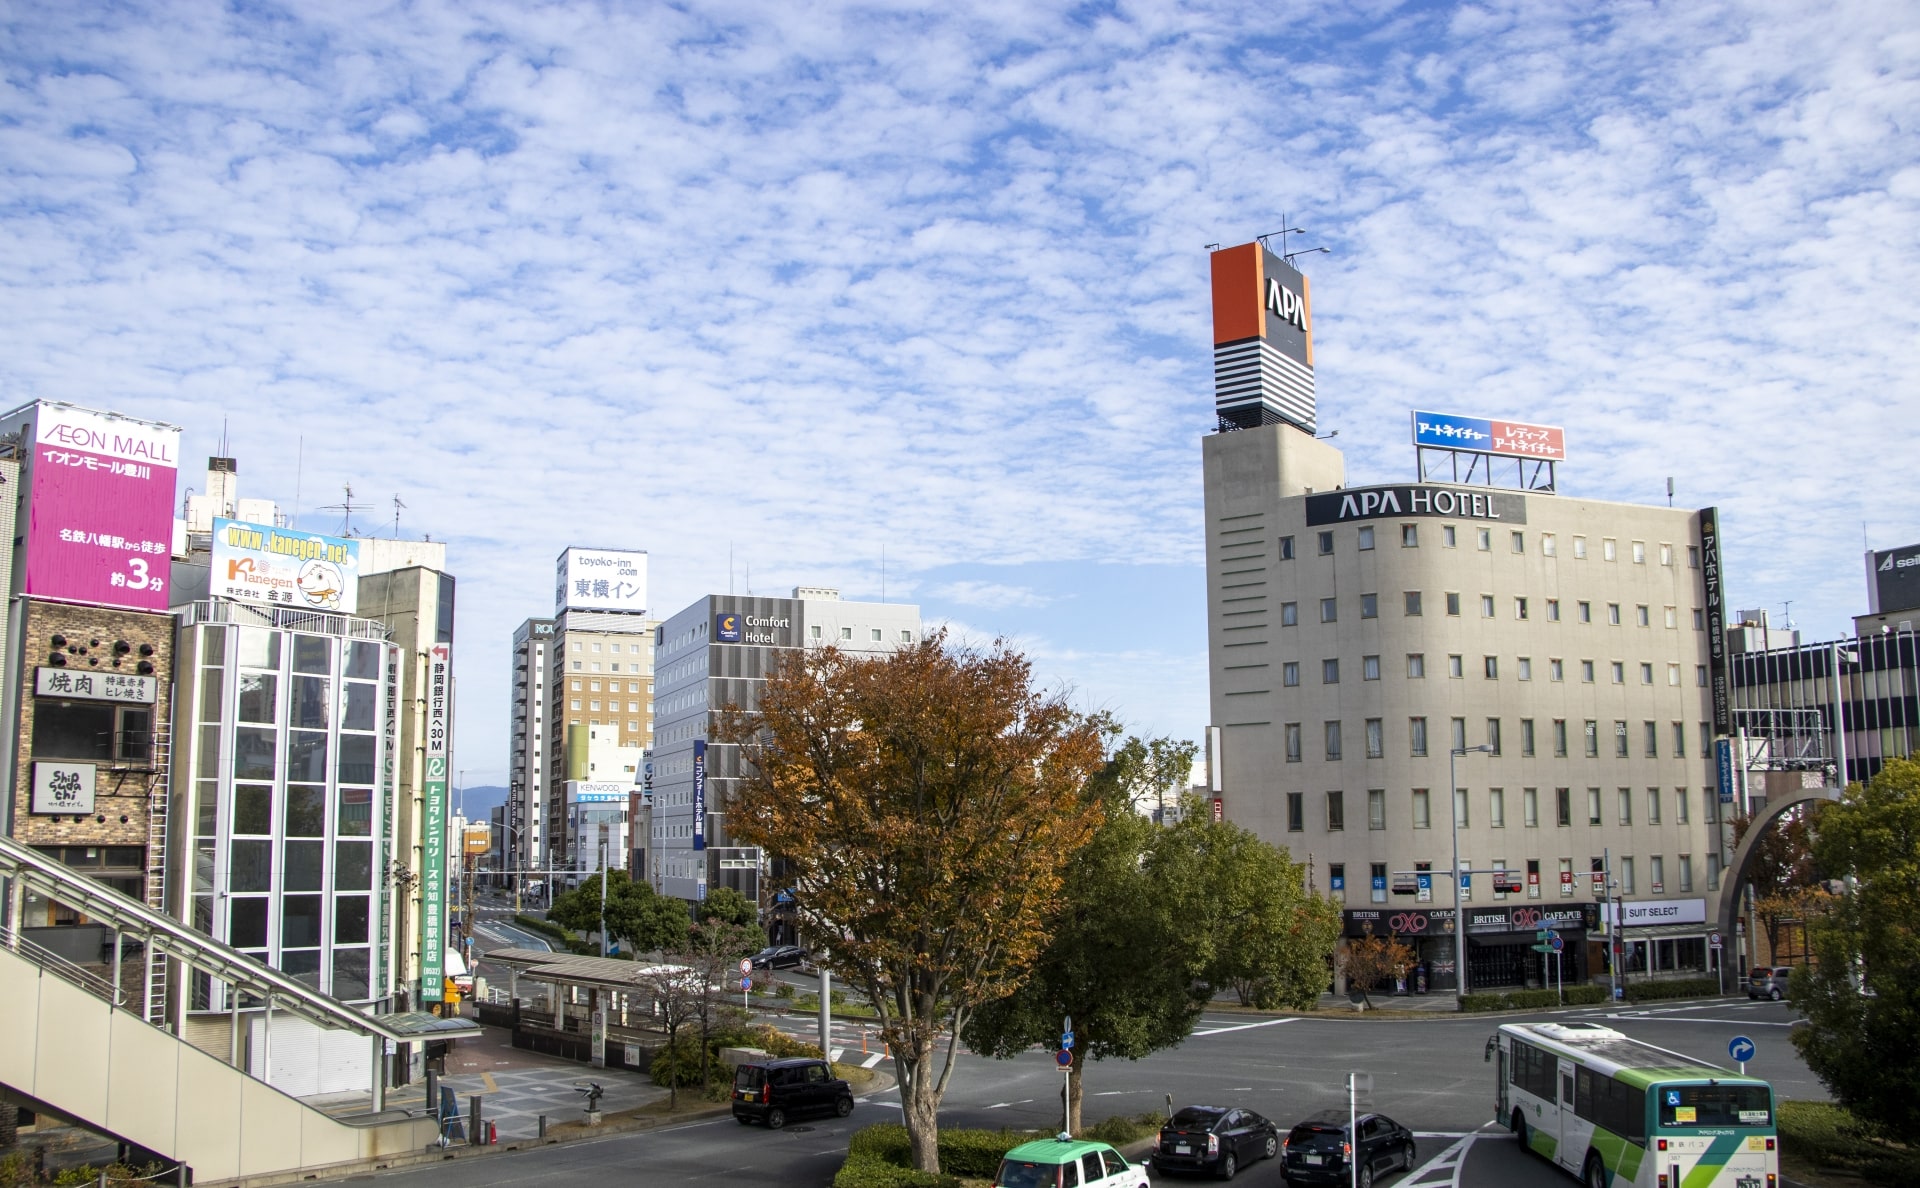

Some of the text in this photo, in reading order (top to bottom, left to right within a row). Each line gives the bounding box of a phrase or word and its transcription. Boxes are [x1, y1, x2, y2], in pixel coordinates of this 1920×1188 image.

[1268, 277, 1308, 332] APA
[1418, 422, 1489, 440] アートネイチャー
[1505, 426, 1550, 441] レディース
[114, 435, 172, 463] MALL
[1493, 437, 1562, 454] アートネイチャー
[42, 450, 150, 480] イオンモール豊川
[1338, 489, 1501, 519] APA HOTEL
[59, 528, 166, 555] 名鉄八幡駅から徒歩
[228, 526, 349, 565] www.kanegen.net
[578, 556, 632, 568] toyoko-inn
[1896, 554, 1920, 568] sei
[110, 557, 164, 592] 約3分
[227, 557, 293, 589] Kanegen
[1703, 535, 1719, 607] アパホテル
[226, 587, 293, 603] 株式会社 金源
[574, 579, 640, 599] 東横イン
[745, 615, 789, 628] Comfort
[745, 631, 775, 644] Hotel
[48, 672, 93, 695] 焼肉
[105, 676, 146, 689] 特選赤身
[105, 688, 145, 701] ヒレ焼き
[580, 784, 620, 792] KENWOOD
[1473, 914, 1505, 924] BRITISH
[1629, 907, 1679, 918] SUIT SELECT
